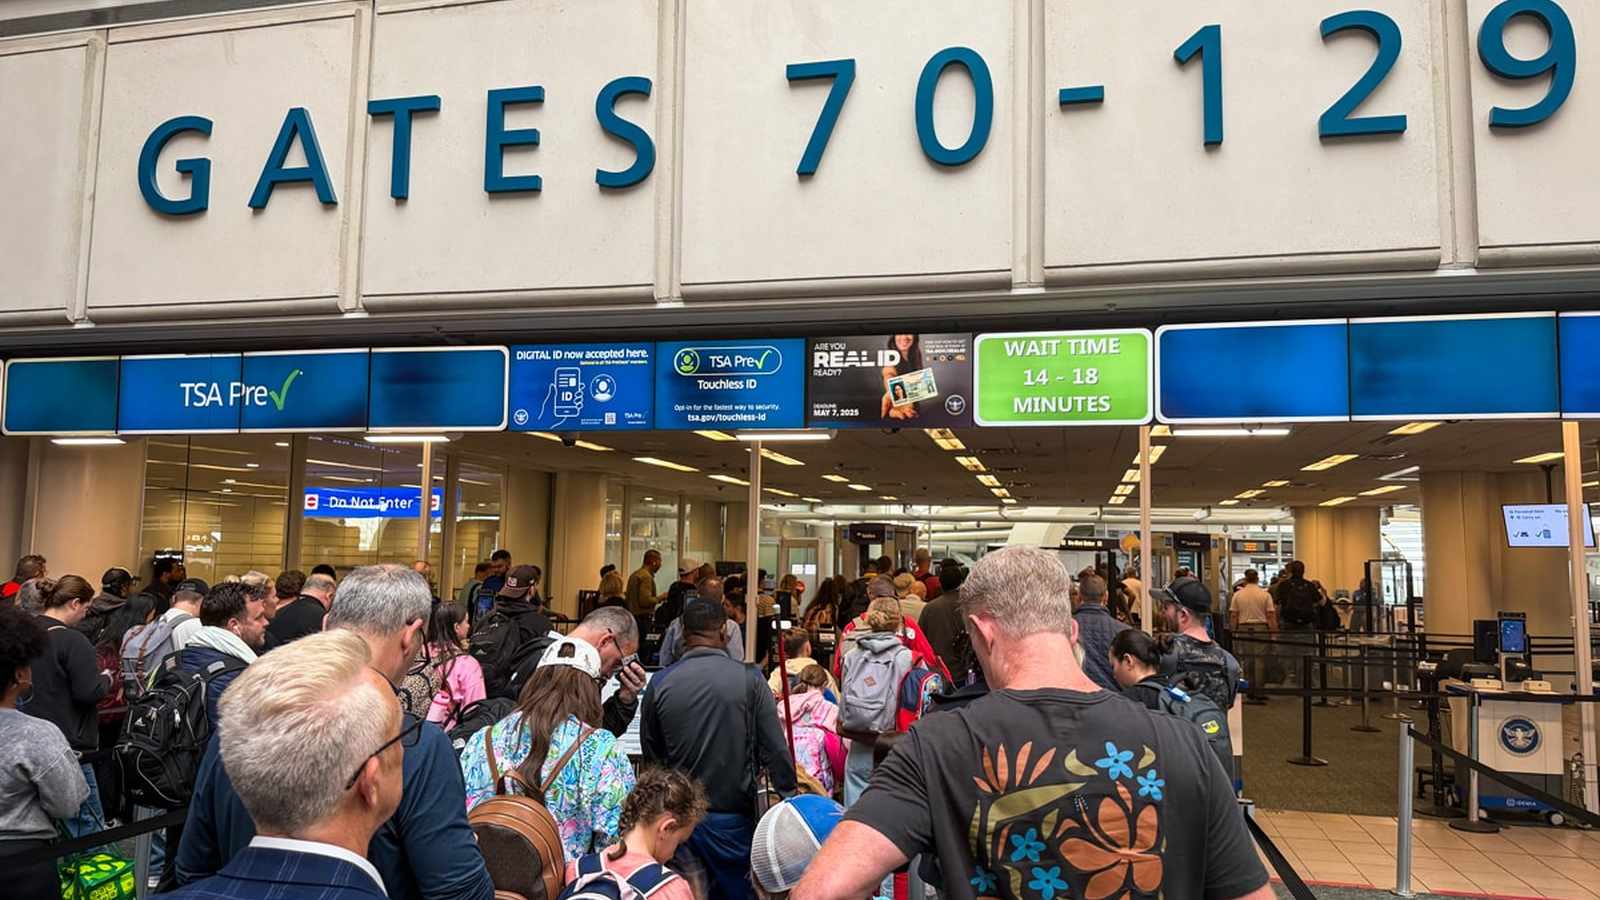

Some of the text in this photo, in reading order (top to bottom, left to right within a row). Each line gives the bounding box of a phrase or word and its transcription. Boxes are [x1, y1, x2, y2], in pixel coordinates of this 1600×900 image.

[137, 76, 656, 216] GATES
[1004, 338, 1121, 356] WAIT TIME
[516, 348, 649, 361] DIGITAL ID now accepted here.
[814, 350, 900, 367] REAL ID
[709, 355, 755, 368] TSA Pre
[1024, 369, 1048, 386] 14
[1073, 368, 1099, 384] 18
[697, 379, 757, 390] Touchless ID
[180, 382, 268, 407] TSA Pre
[561, 391, 573, 401] ID
[674, 404, 693, 412] Opt-in
[1014, 396, 1111, 413] MINUTES
[687, 413, 766, 422] tsa.gov/touchless-id
[813, 409, 859, 417] MAY 7, 2025
[330, 496, 413, 509] Do Not Enter
